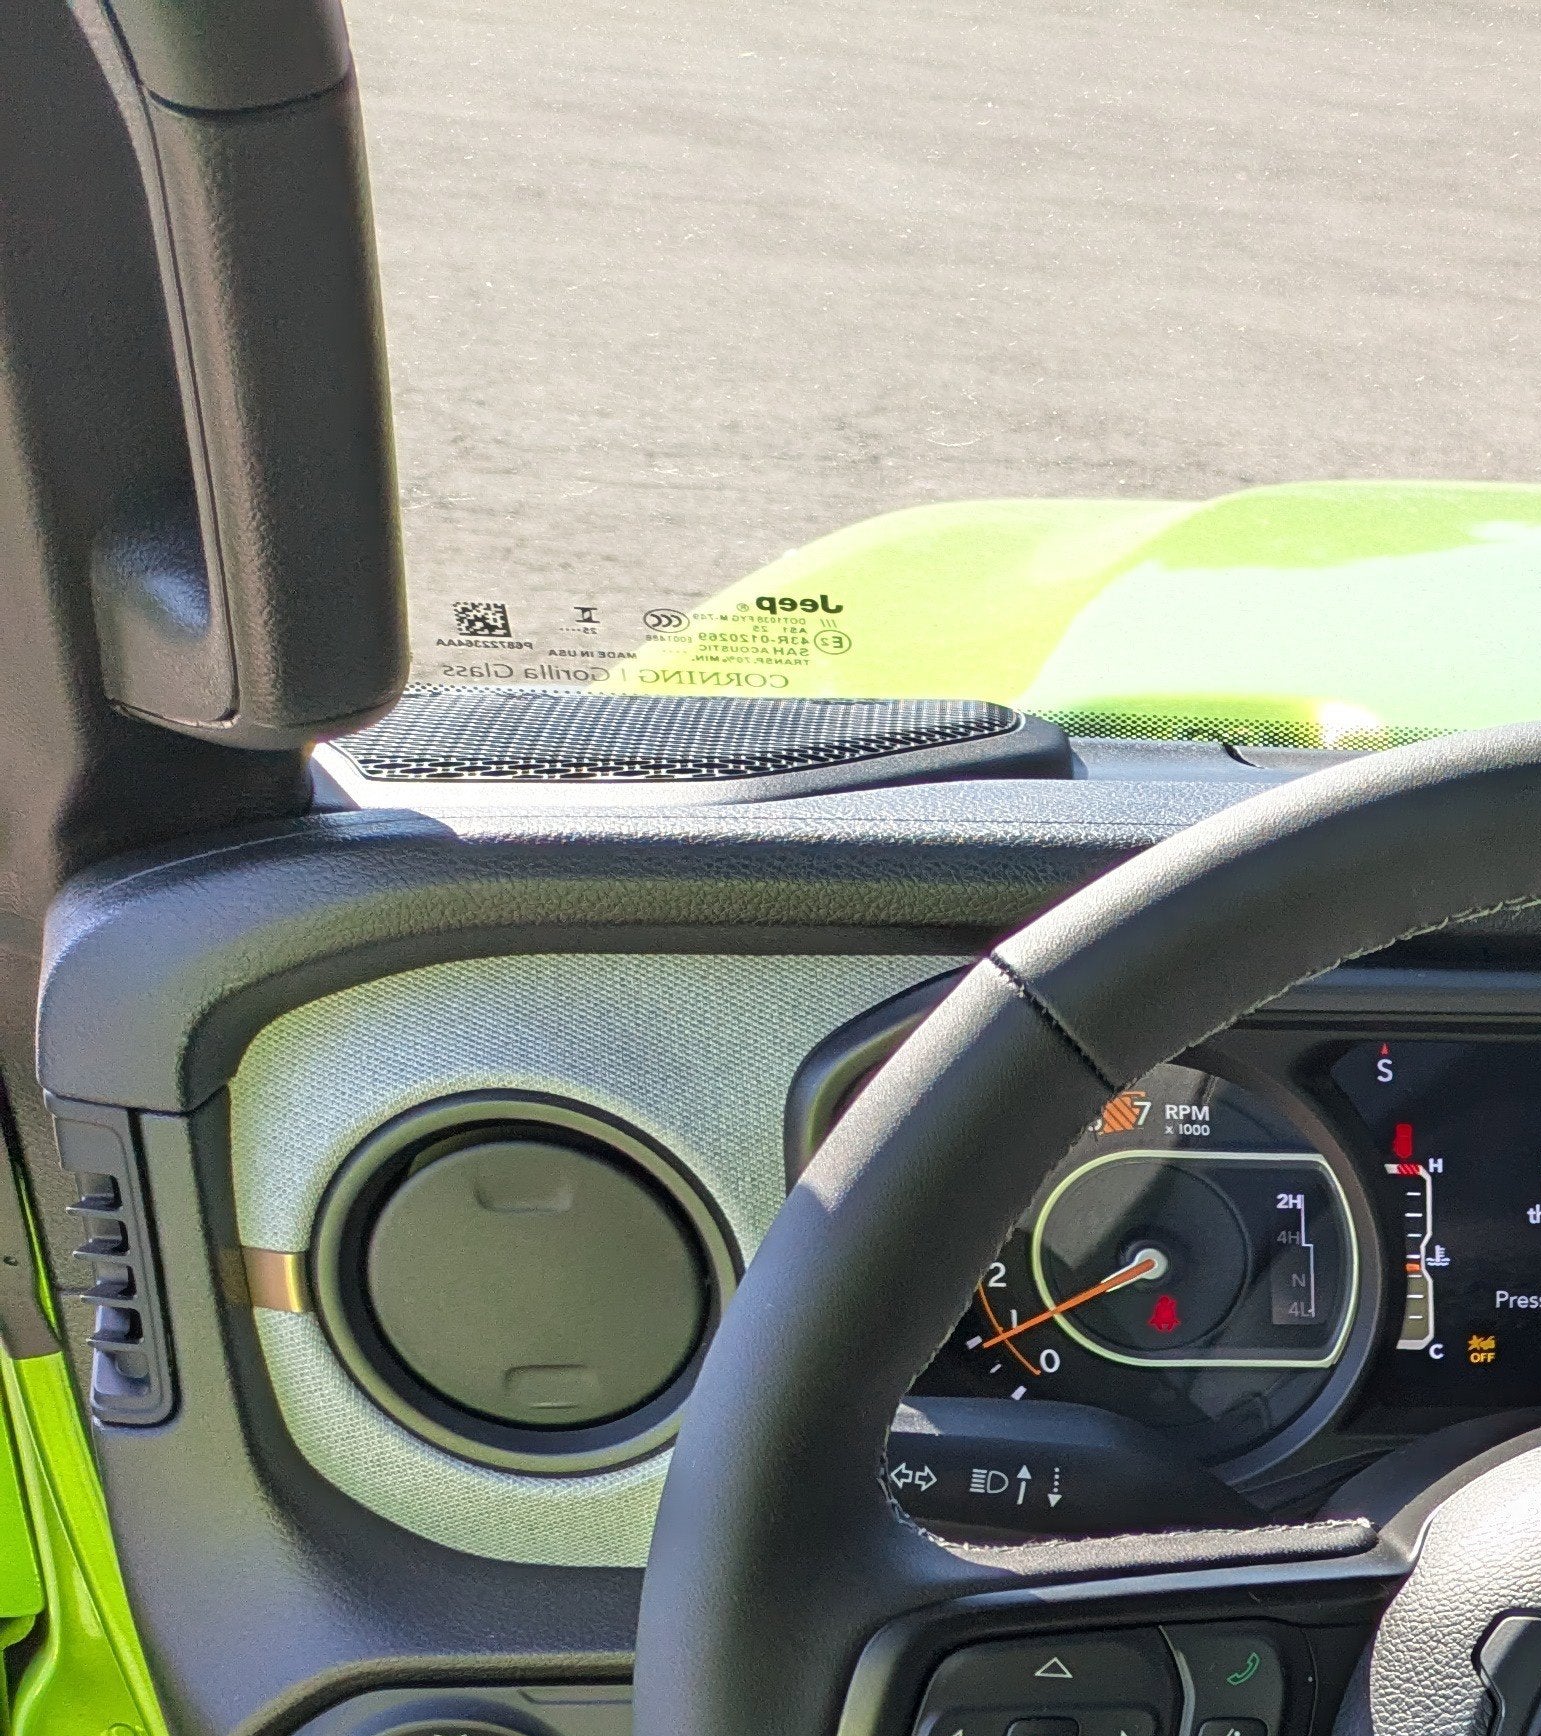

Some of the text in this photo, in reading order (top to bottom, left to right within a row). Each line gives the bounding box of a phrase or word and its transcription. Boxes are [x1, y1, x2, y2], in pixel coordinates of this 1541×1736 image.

[1377, 1059, 1393, 1082] S
[1165, 1105, 1209, 1121] RPM
[1179, 1124, 1210, 1136] 1000
[1429, 1159, 1443, 1173] H
[1277, 1194, 1302, 1209] 2H
[1430, 1345, 1444, 1359] C
[1470, 1353, 1495, 1363] OFF
